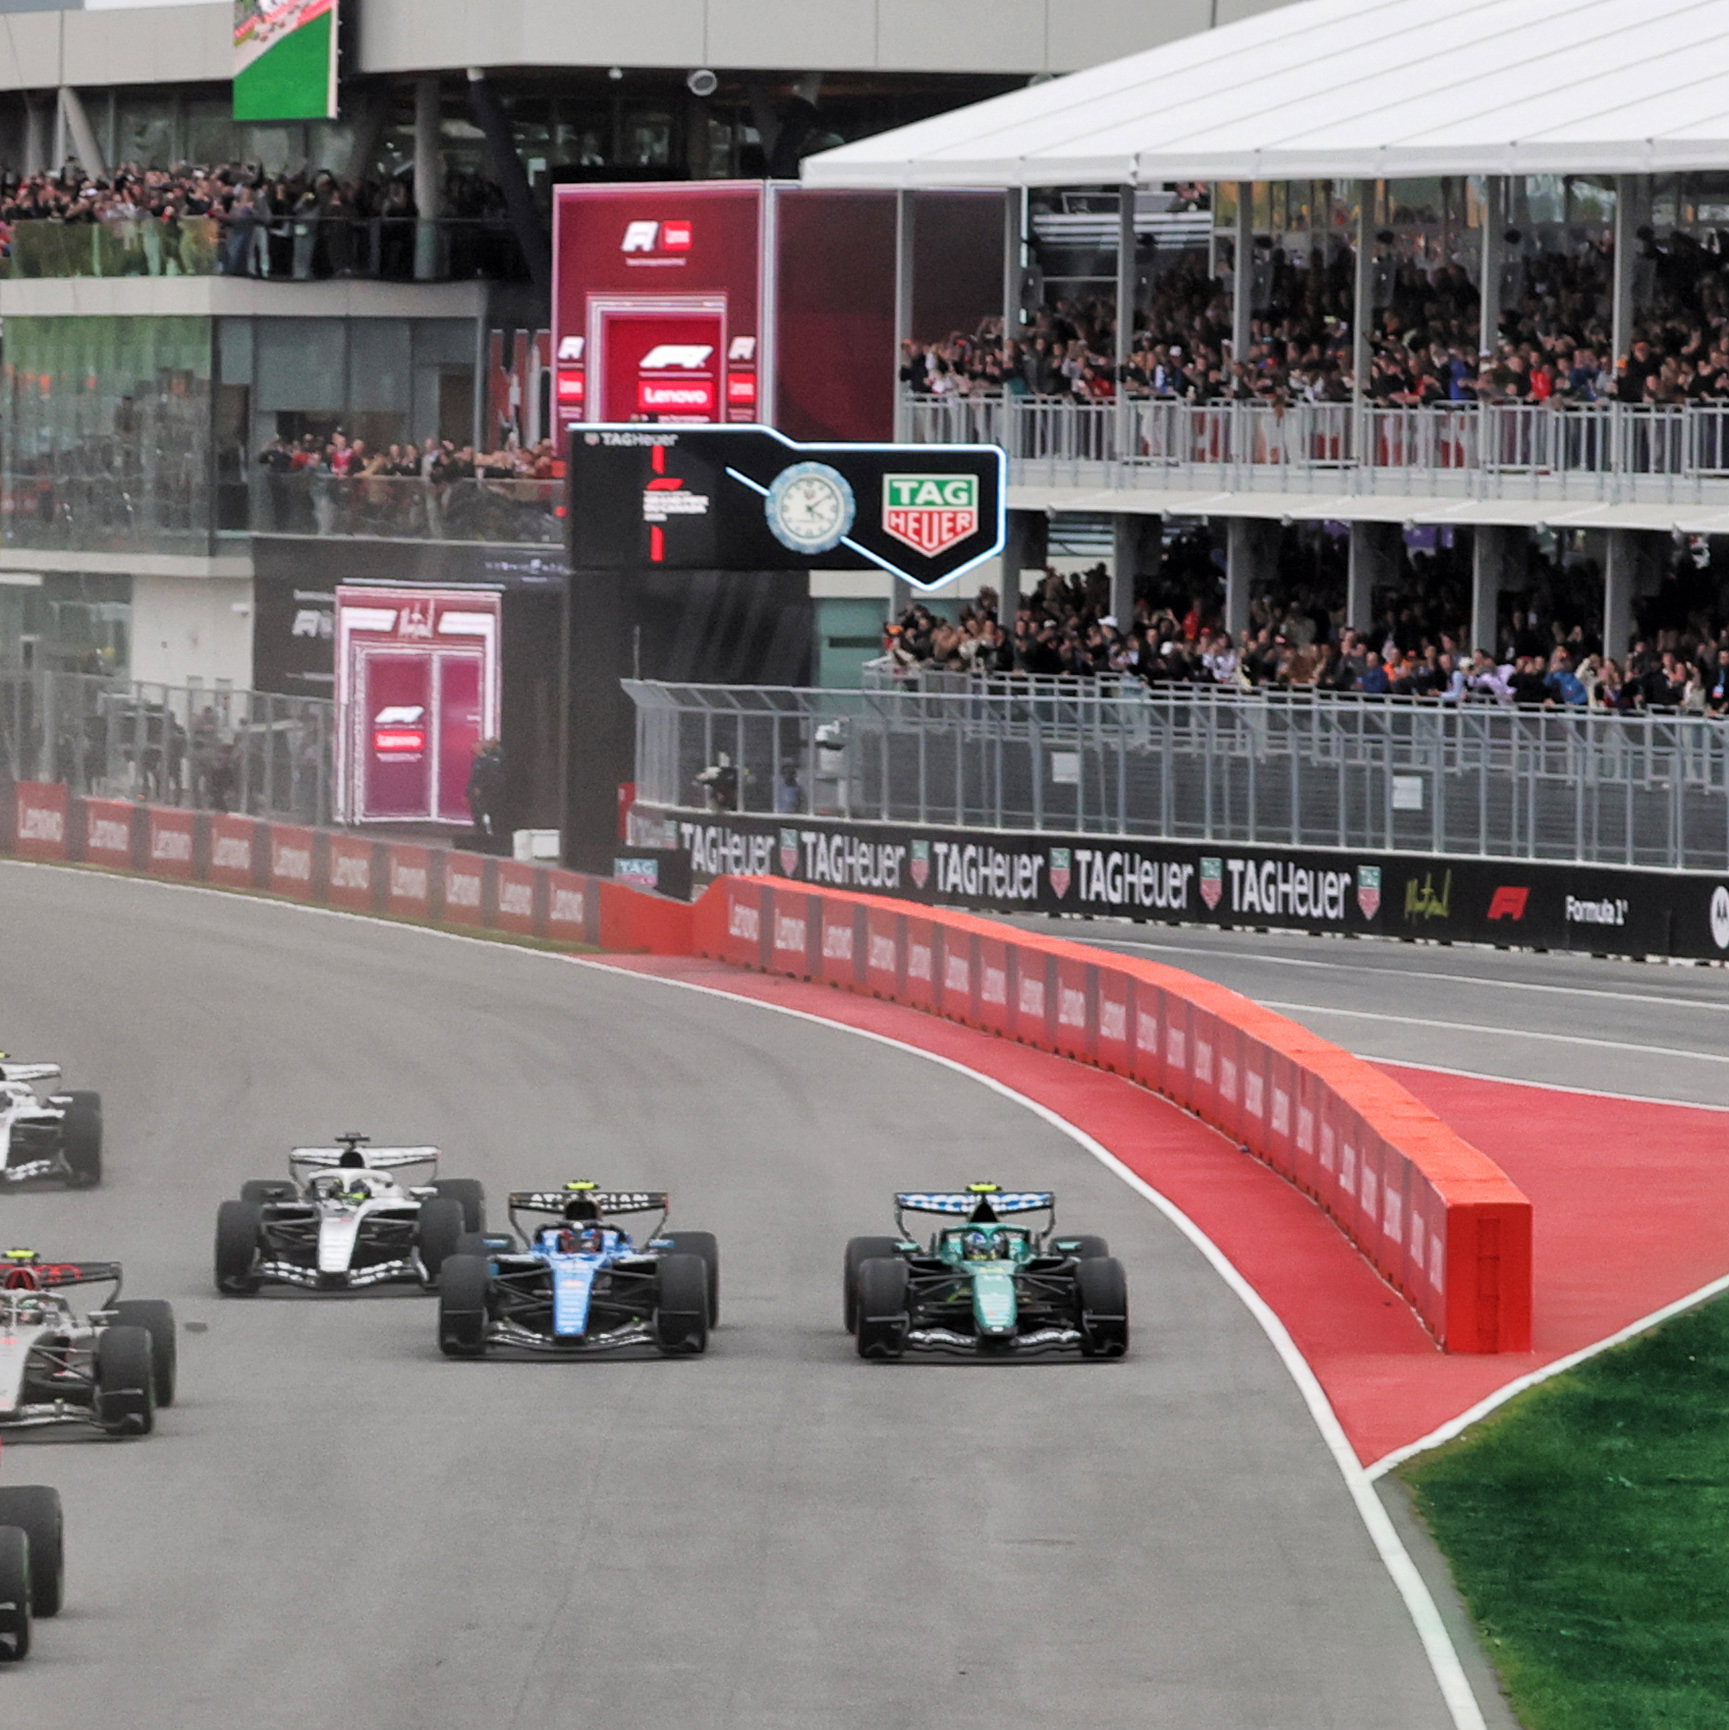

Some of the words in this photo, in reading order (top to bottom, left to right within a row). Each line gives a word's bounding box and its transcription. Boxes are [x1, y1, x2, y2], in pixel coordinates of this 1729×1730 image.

[644, 386, 707, 404] Lenovo
[892, 481, 969, 505] TAG
[890, 511, 973, 549] HEUER
[18, 797, 63, 841] Lenovo
[1565, 895, 1614, 923] Formula
